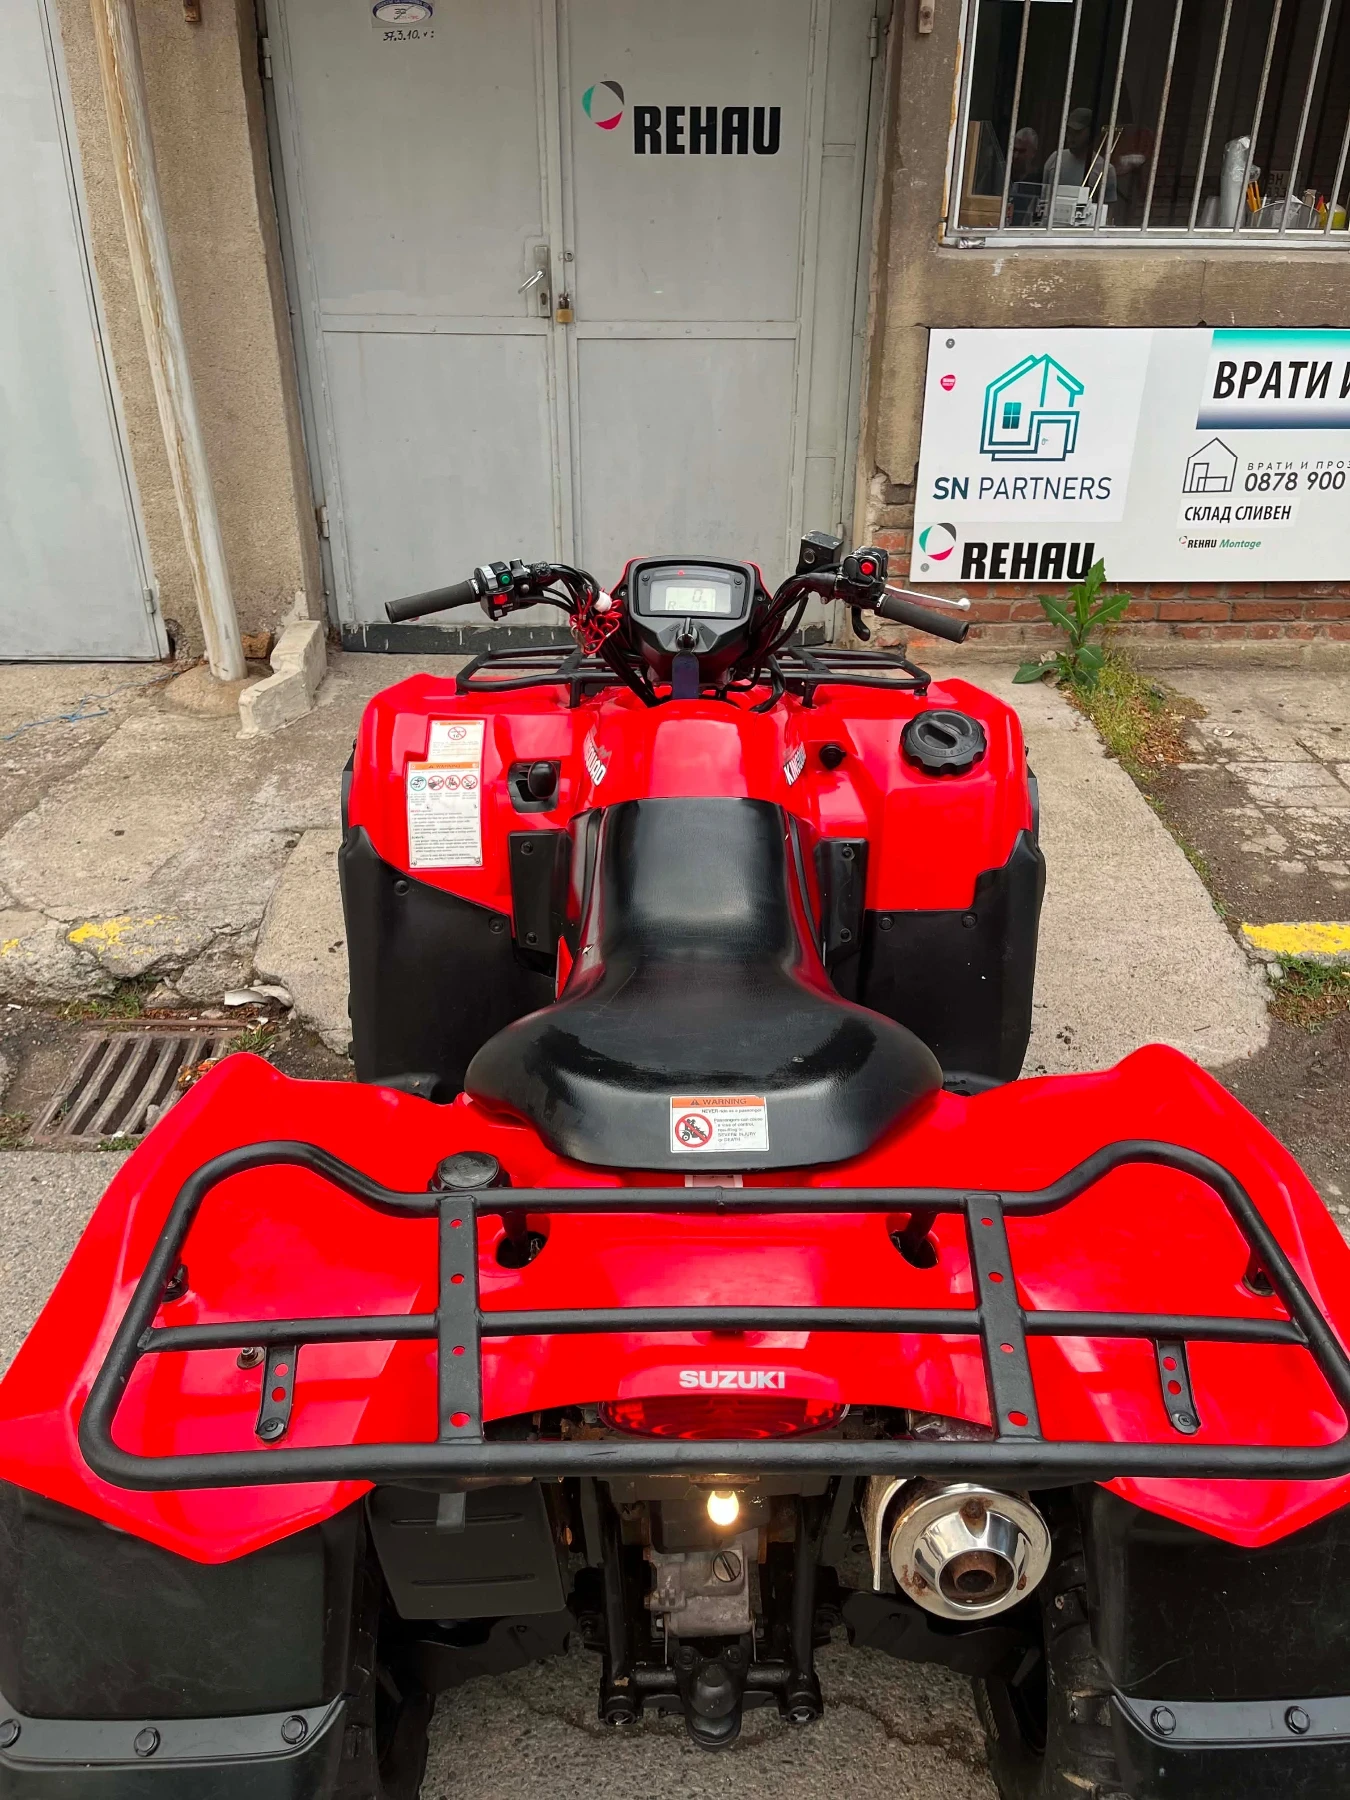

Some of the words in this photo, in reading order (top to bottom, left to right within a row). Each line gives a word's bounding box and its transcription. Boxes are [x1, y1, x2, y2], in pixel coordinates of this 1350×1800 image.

[633, 106, 781, 155] REHAU
[1212, 361, 1333, 399] ВРАТИ
[1247, 461, 1293, 471] ВРАТИ
[1300, 461, 1309, 470] И
[932, 476, 970, 500] SN
[978, 476, 1113, 500] PARTNERS
[1244, 472, 1299, 492] 0878
[1307, 470, 1346, 491] 900
[1184, 506, 1232, 523] СКЛАД
[1235, 505, 1292, 521] СЛИВЕН
[1187, 539, 1218, 549] REHAU
[1219, 539, 1262, 550] Montage
[960, 542, 1096, 580] REHAU
[678, 1370, 786, 1389] SUZUKI
